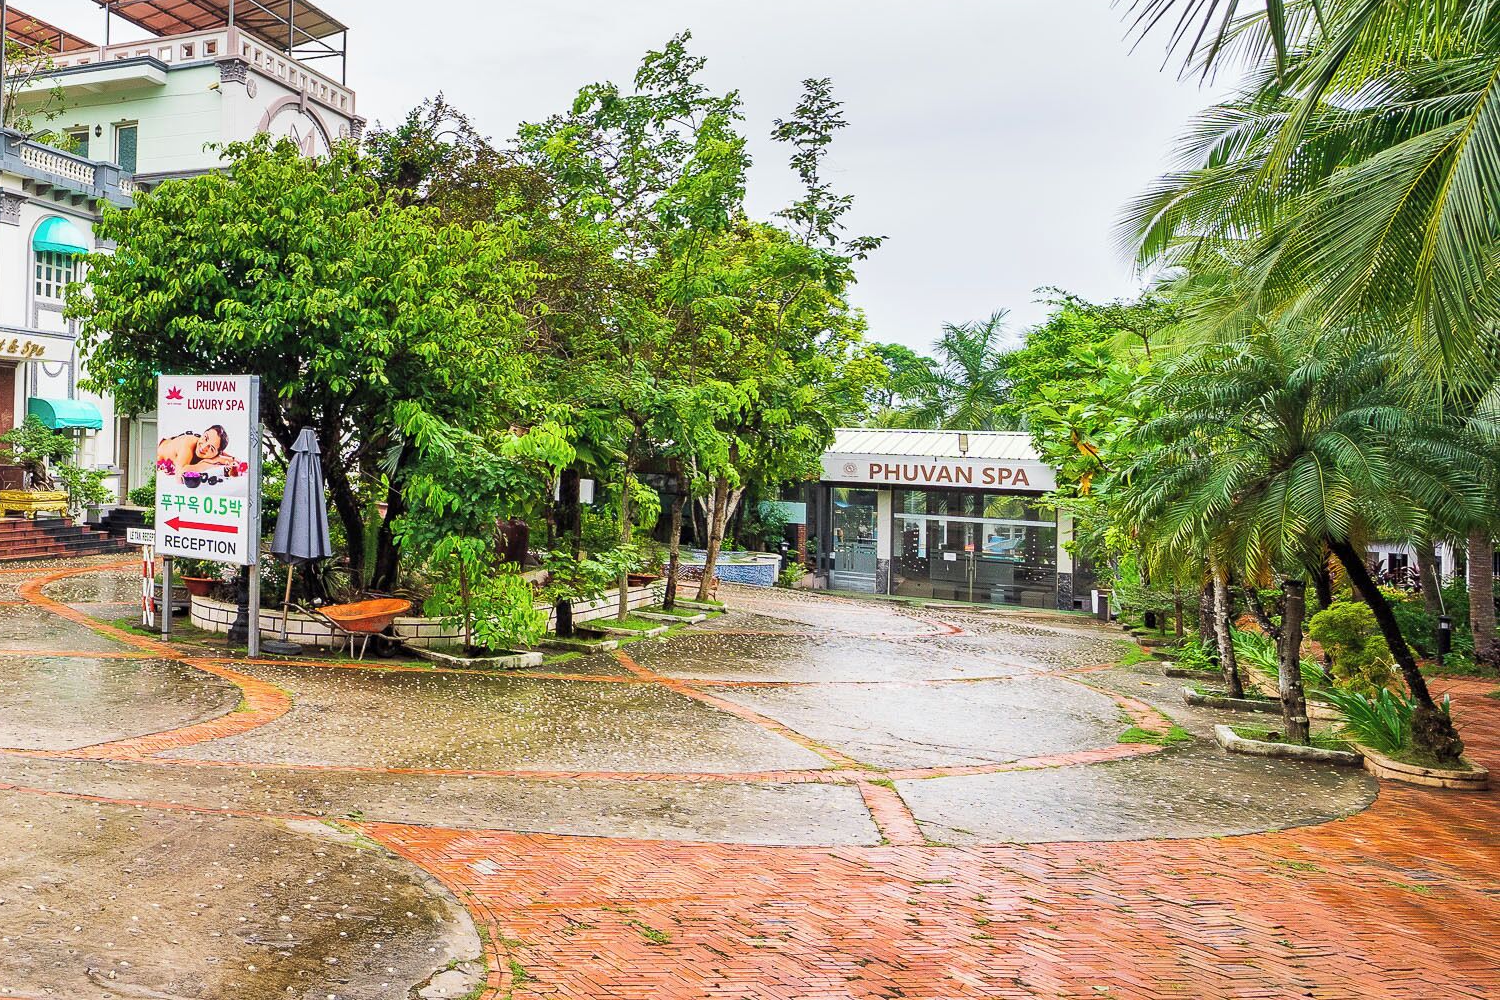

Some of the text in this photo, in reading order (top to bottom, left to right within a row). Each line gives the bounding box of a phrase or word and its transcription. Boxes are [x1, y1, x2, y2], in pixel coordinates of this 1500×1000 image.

[20, 339, 47, 358] Spa
[196, 380, 236, 392] PHUVAN
[187, 398, 245, 411] LUXURY SPA
[869, 463, 1030, 486] PHUVAN SPA
[160, 493, 242, 518] 푸꾸옥 0.5박
[164, 534, 236, 555] RECEPTION
